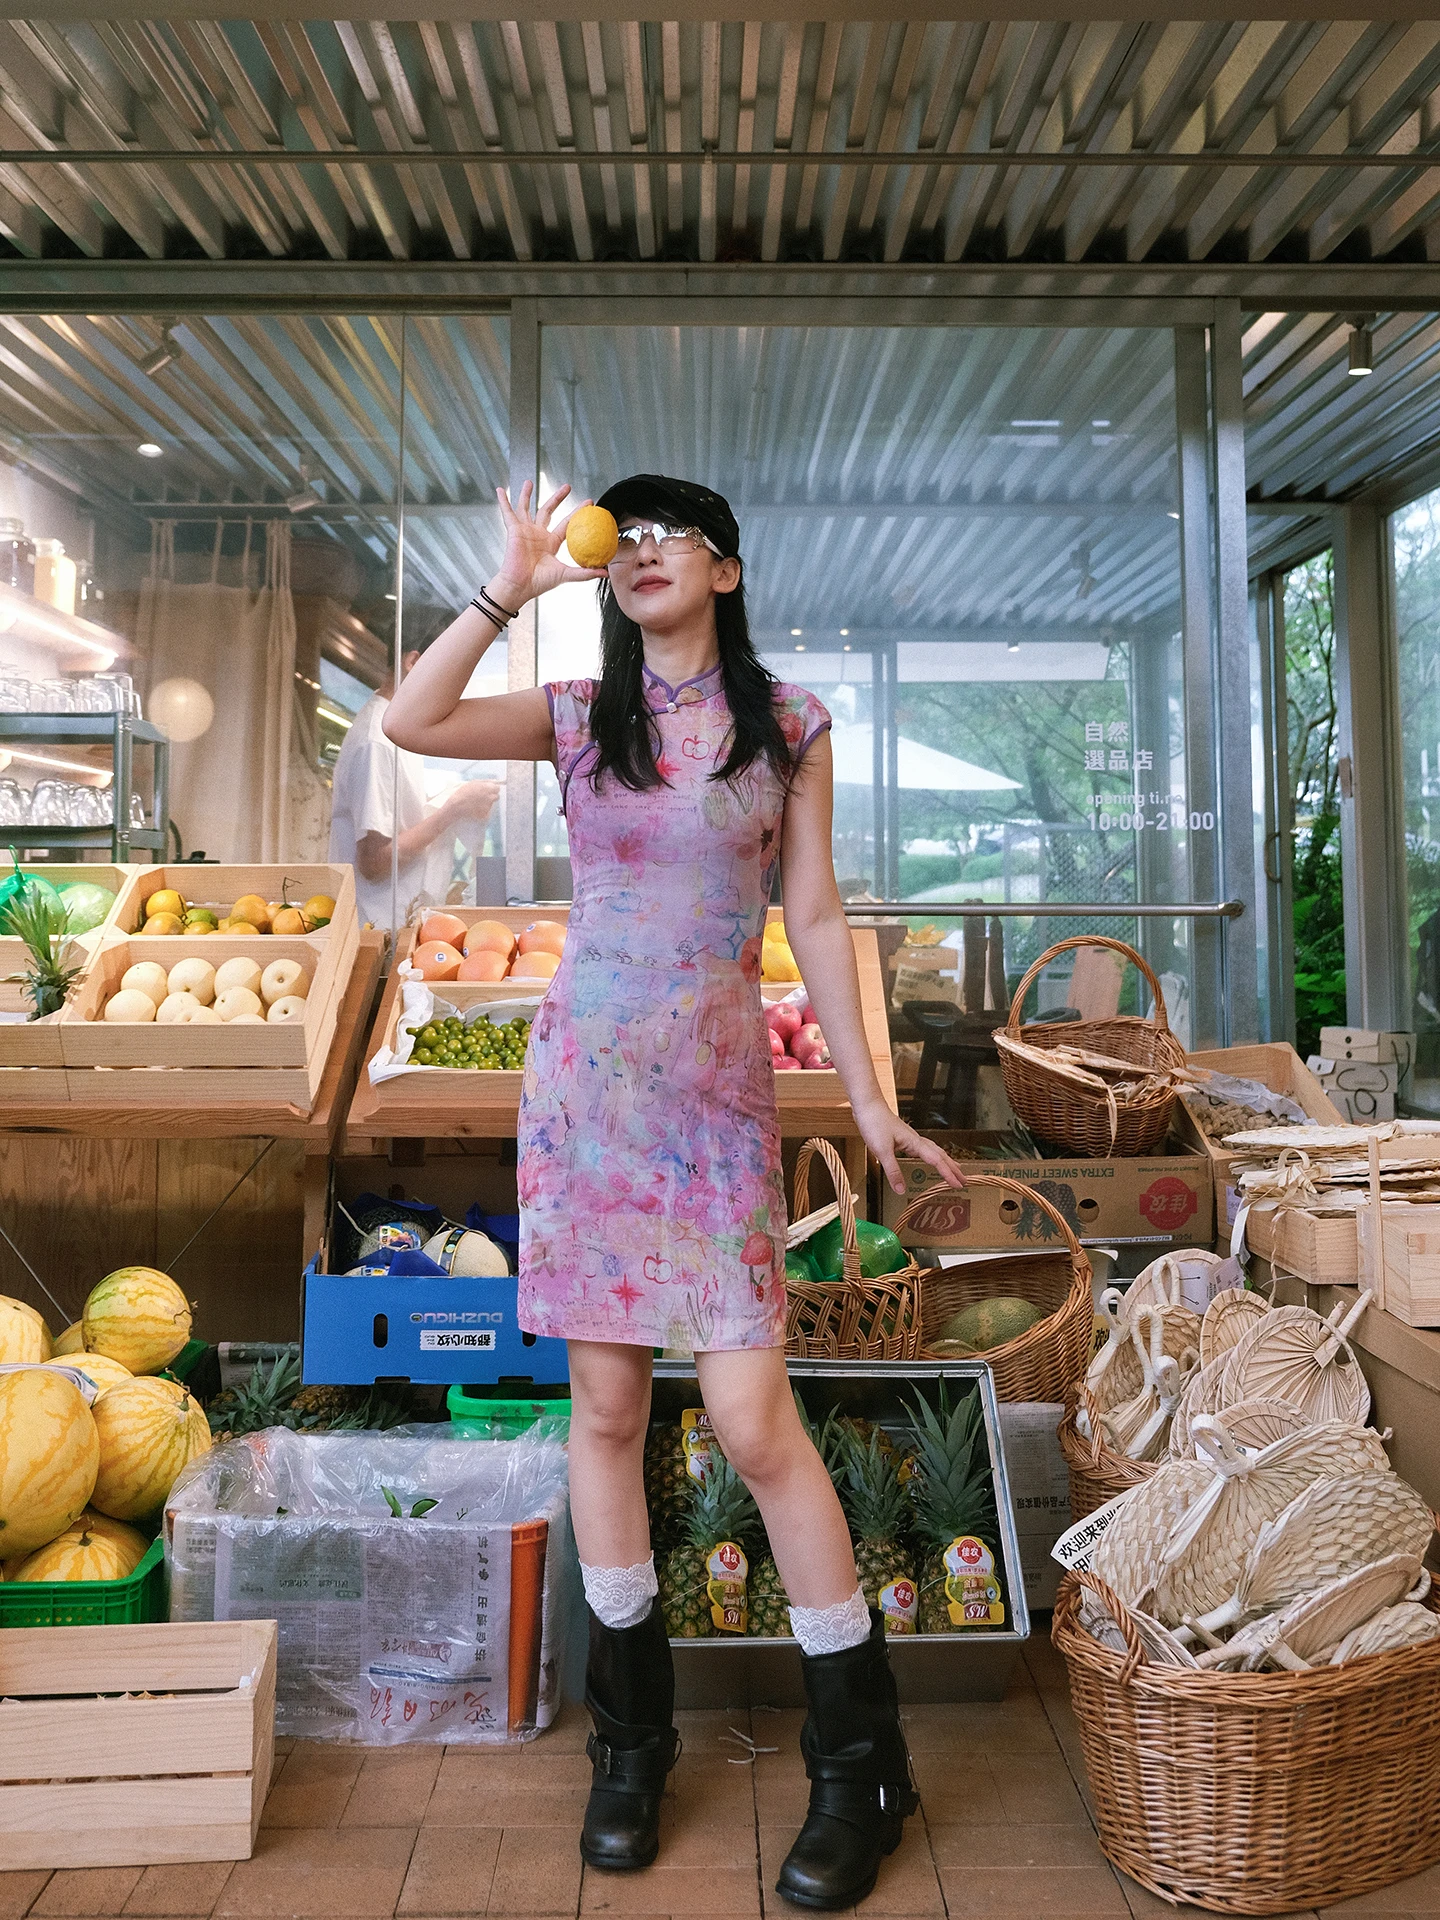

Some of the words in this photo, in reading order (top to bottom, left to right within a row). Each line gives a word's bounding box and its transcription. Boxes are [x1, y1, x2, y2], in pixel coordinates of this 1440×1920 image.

[1084, 721, 1129, 743] 自然
[1084, 749, 1154, 771] 選品店
[1086, 792, 1145, 808] opening
[1087, 812, 1215, 831] 10:00-21:00
[1041, 1168, 1079, 1179] SWEET
[1080, 1167, 1114, 1178] EXTRA
[437, 1333, 491, 1347] 都知心纹
